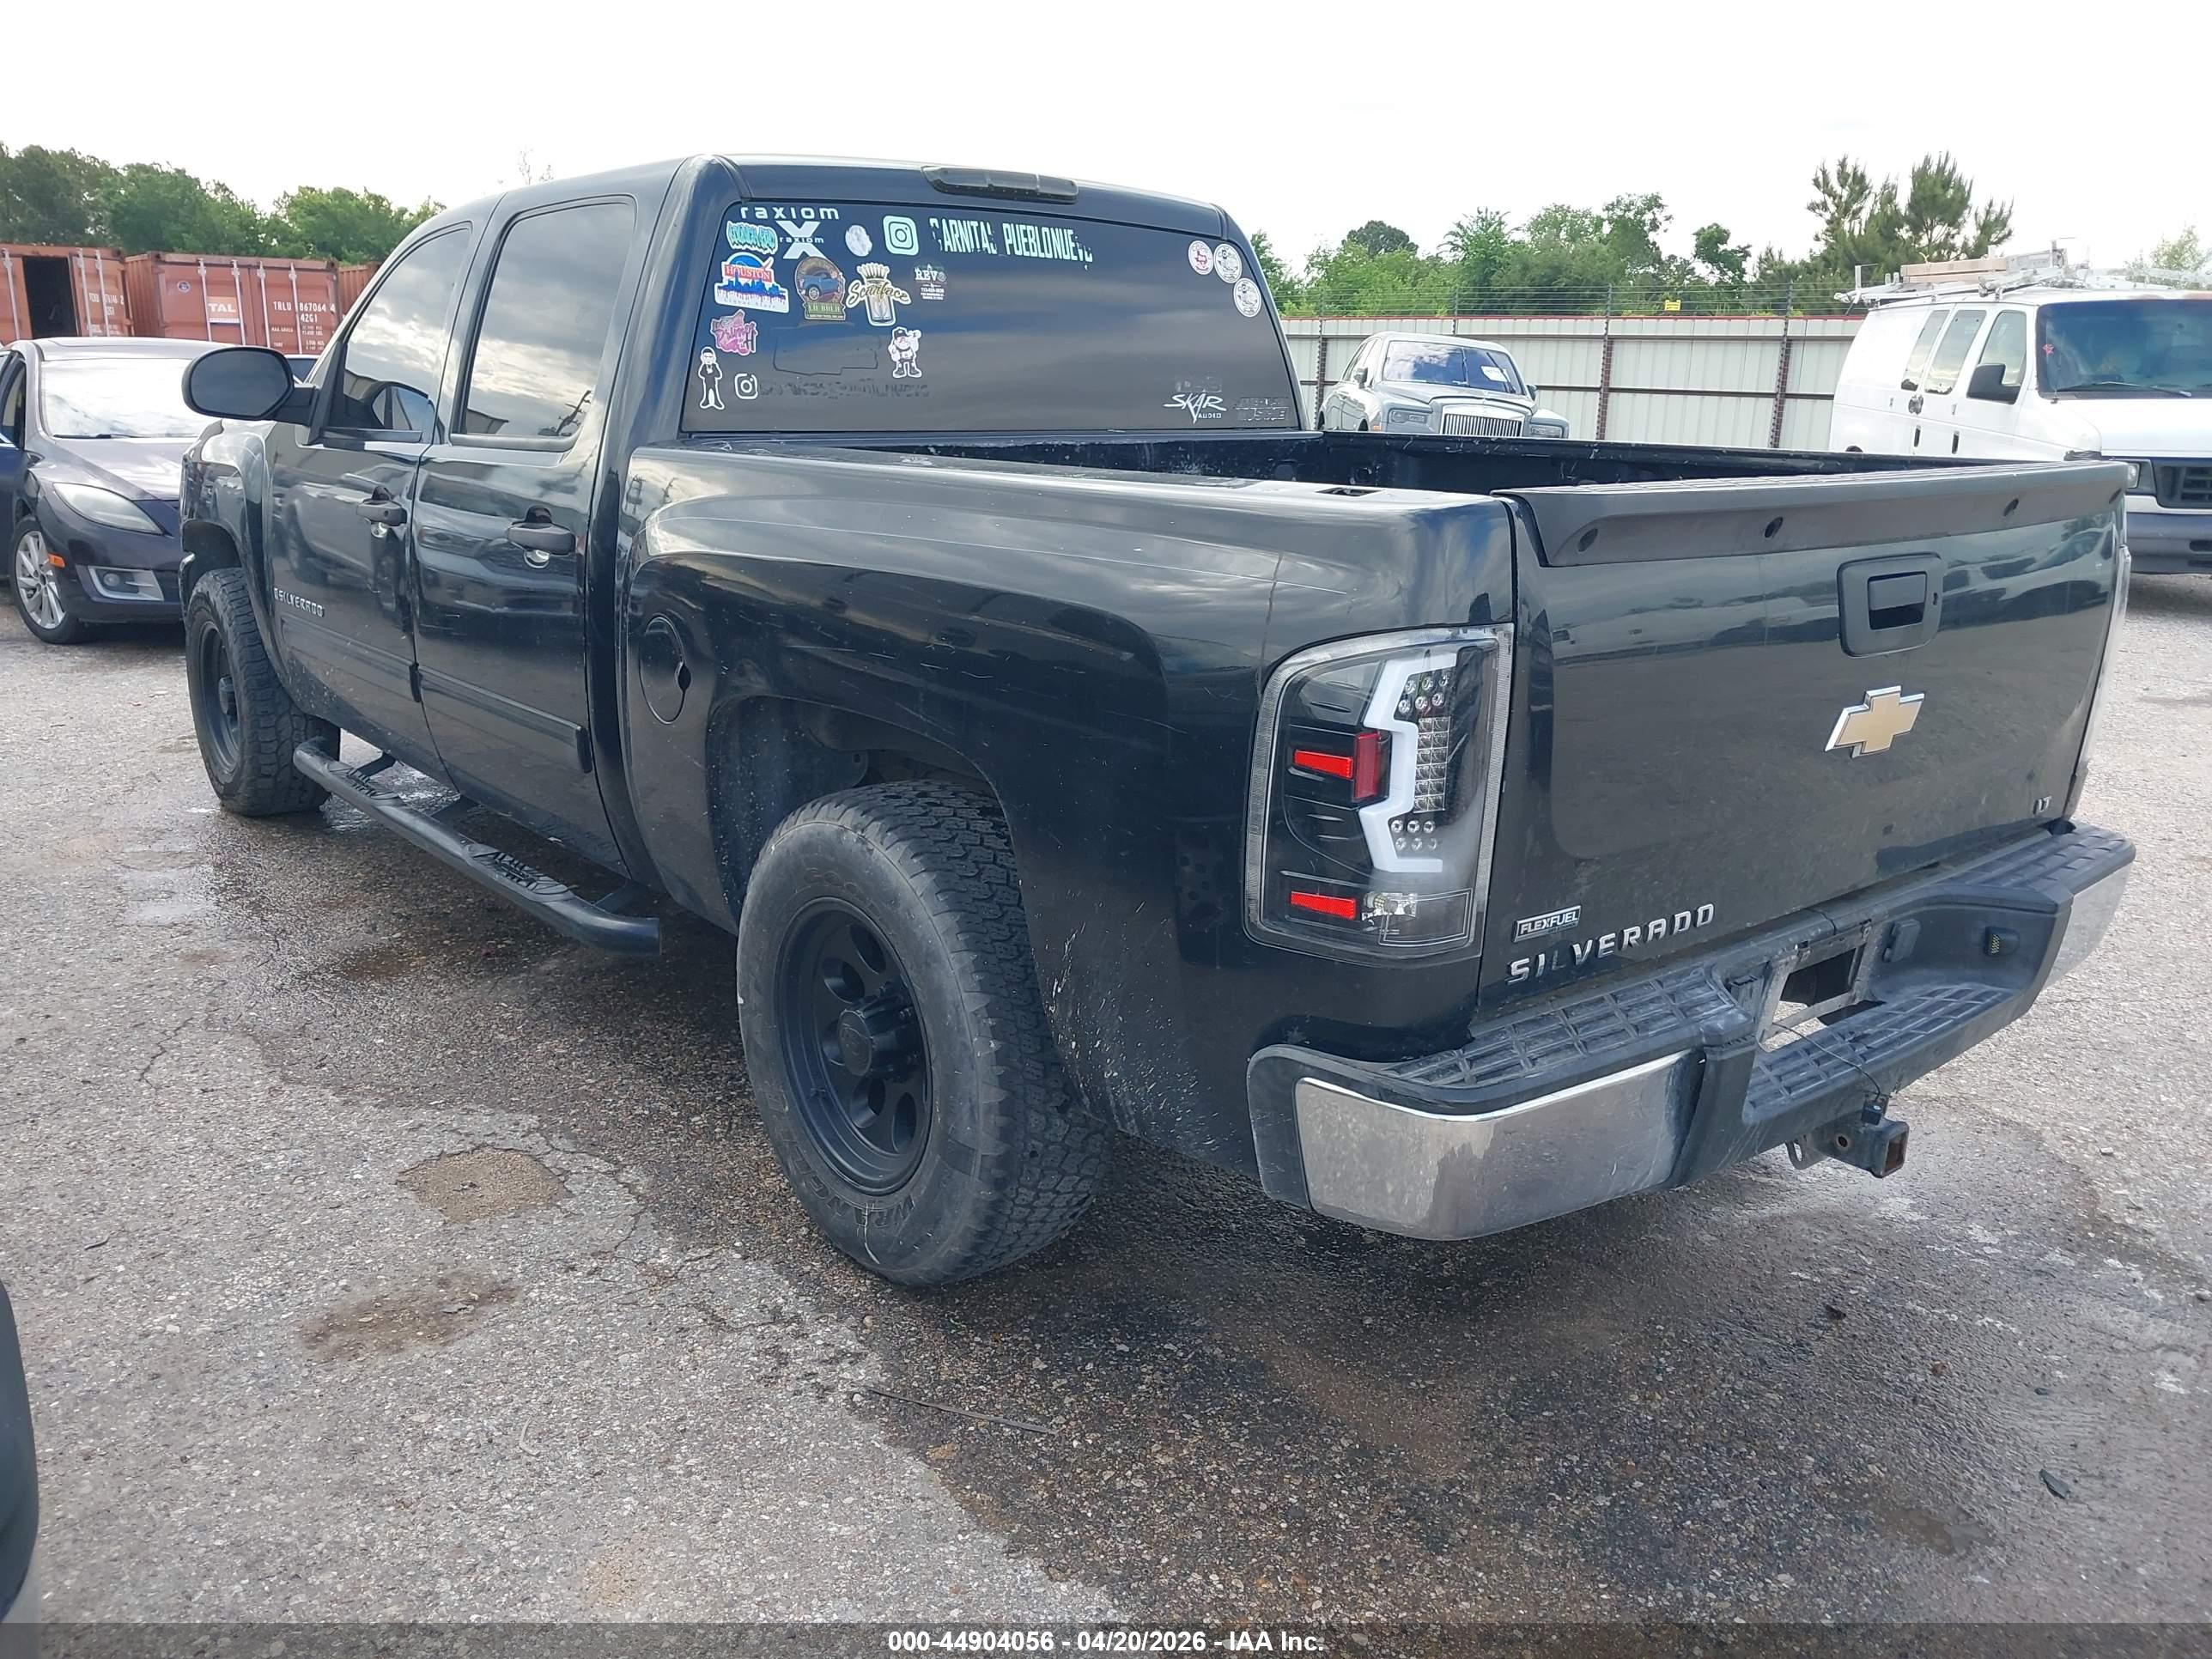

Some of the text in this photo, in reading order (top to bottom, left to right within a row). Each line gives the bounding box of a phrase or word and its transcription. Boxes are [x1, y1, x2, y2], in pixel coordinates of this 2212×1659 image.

[740, 207, 839, 220] raxiom
[725, 265, 771, 283] HOUSTON
[847, 279, 909, 306] Scarface
[208, 303, 237, 313] TAL
[273, 301, 292, 311] TRLU
[1163, 393, 1227, 424] SKAR
[278, 590, 324, 617] SILVERADO
[1520, 910, 1578, 935] FLEXFUEL
[1506, 903, 1715, 984] SILVERADO
